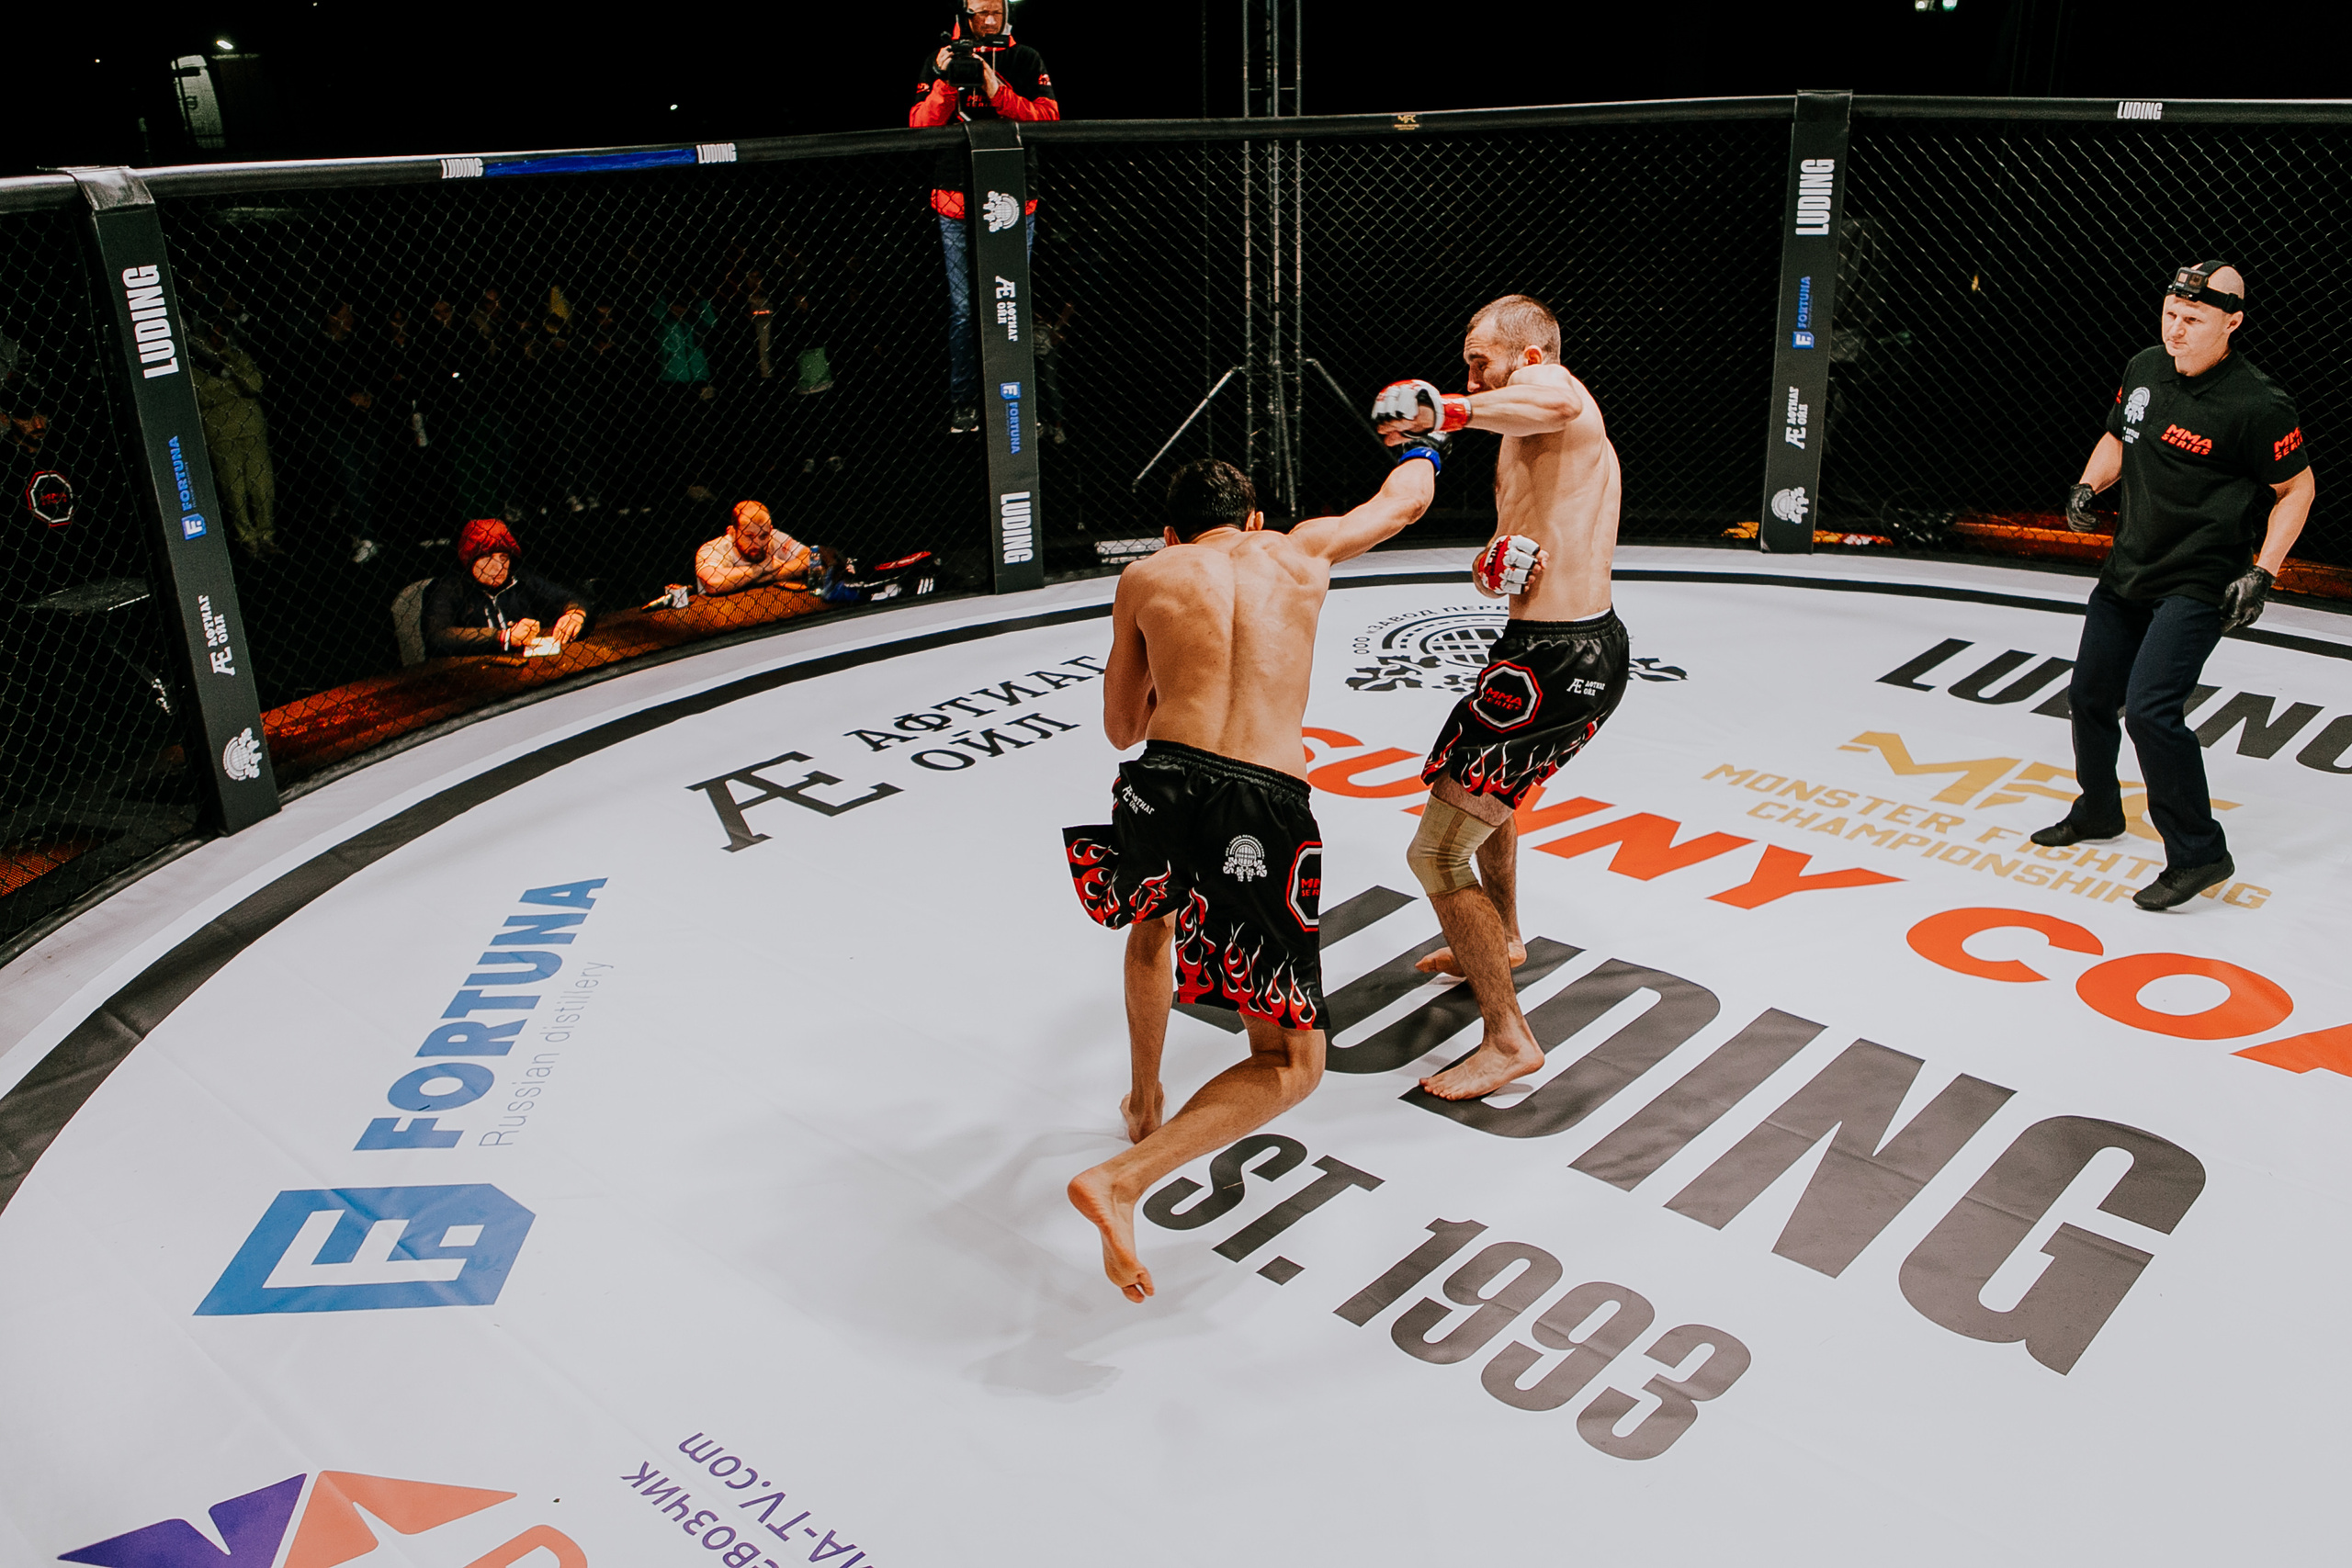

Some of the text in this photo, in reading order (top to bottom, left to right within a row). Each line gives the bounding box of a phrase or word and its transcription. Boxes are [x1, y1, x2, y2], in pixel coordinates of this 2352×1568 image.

[2117, 101, 2163, 120] LUDING
[440, 158, 483, 178] LUDING
[696, 143, 737, 164] LUDING
[1795, 159, 1835, 235] LUDING
[122, 265, 179, 379] LUDING
[1797, 276, 1811, 329] FORTUNA
[1010, 401, 1021, 454] FORTUNA
[2161, 433, 2211, 456] SERIES
[2165, 423, 2212, 449] MMA
[168, 435, 192, 511] FORTUNA
[1001, 491, 1034, 565] LUDING
[842, 656, 1106, 752] АФТИАГ
[1486, 687, 1521, 706] MMA
[910, 713, 1081, 771] ОЙЛ
[1701, 763, 1966, 834] MONSTER
[353, 877, 608, 1151] FORTUNA
[479, 961, 614, 1147] Russian distillery
[1143, 1134, 1751, 1461] ST. 1993
[620, 1461, 779, 1568] ВОЗЧИК
